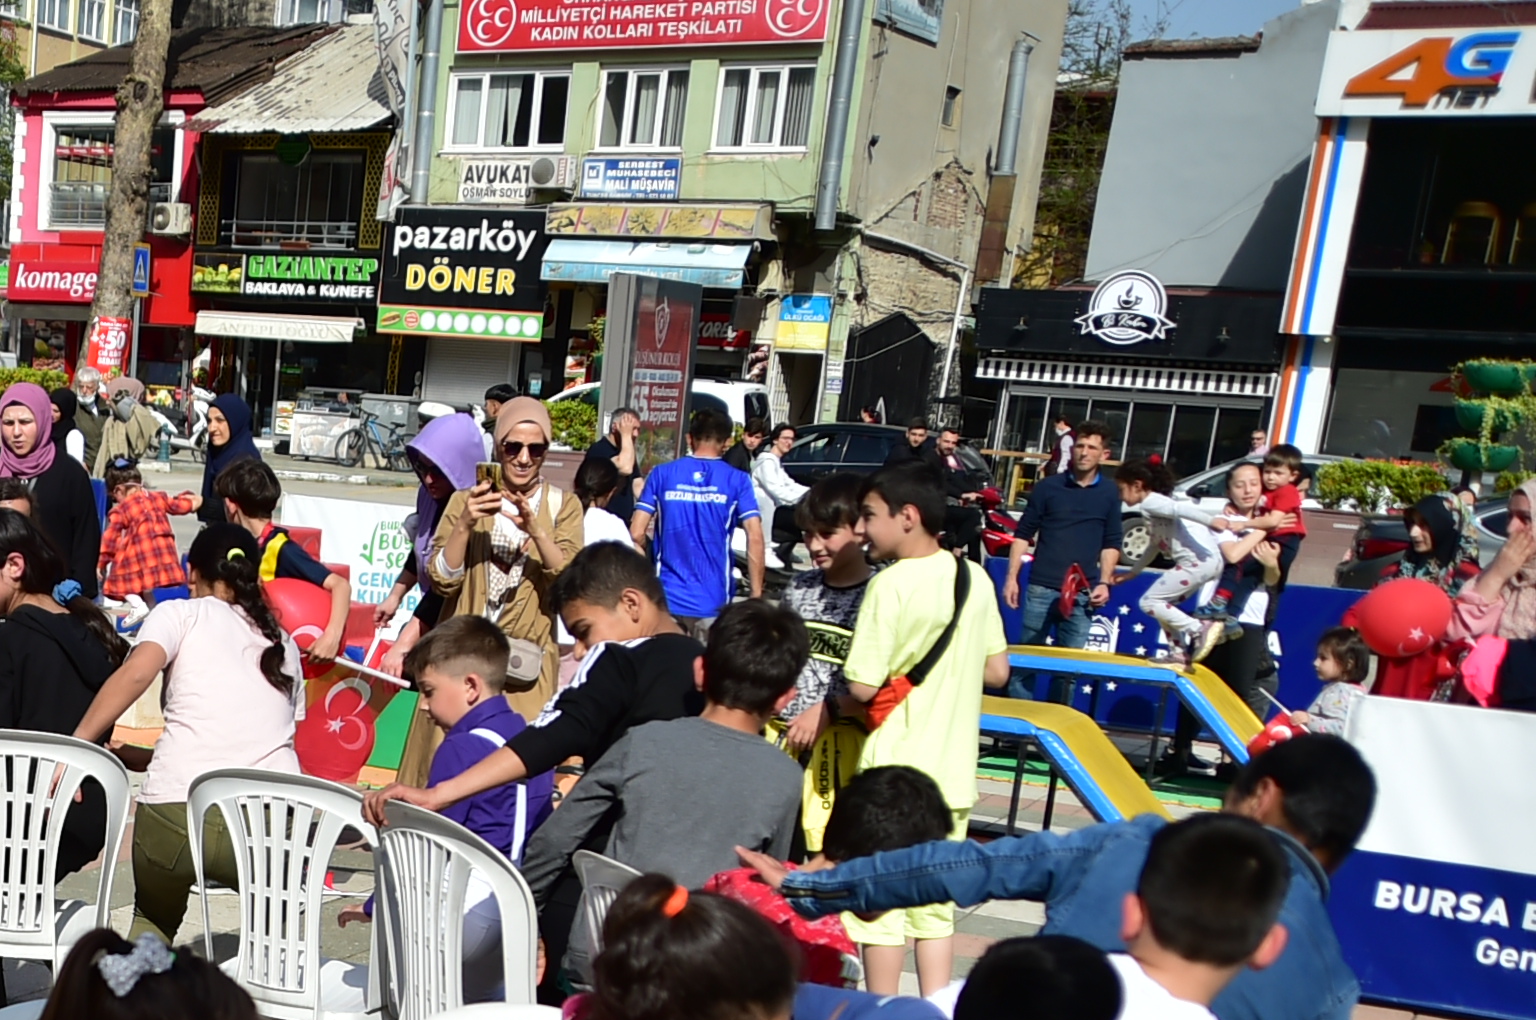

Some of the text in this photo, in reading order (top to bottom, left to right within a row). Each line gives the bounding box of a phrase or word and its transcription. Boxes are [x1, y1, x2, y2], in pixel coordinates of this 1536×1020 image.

[520, 4, 606, 24] MİLLİYETÇİ
[610, 3, 687, 20] HAREKET
[530, 17, 742, 41] KADIN KOLLARI TEŞKİLATI
[462, 186, 497, 198] OSMAN
[605, 178, 629, 190] MALİ
[392, 219, 537, 262] pazarköy
[15, 263, 98, 298] komage
[245, 282, 306, 297] BAKLAVA
[405, 257, 516, 296] DÖNER
[819, 760, 832, 811] adidas
[1374, 879, 1510, 928] BURSA
